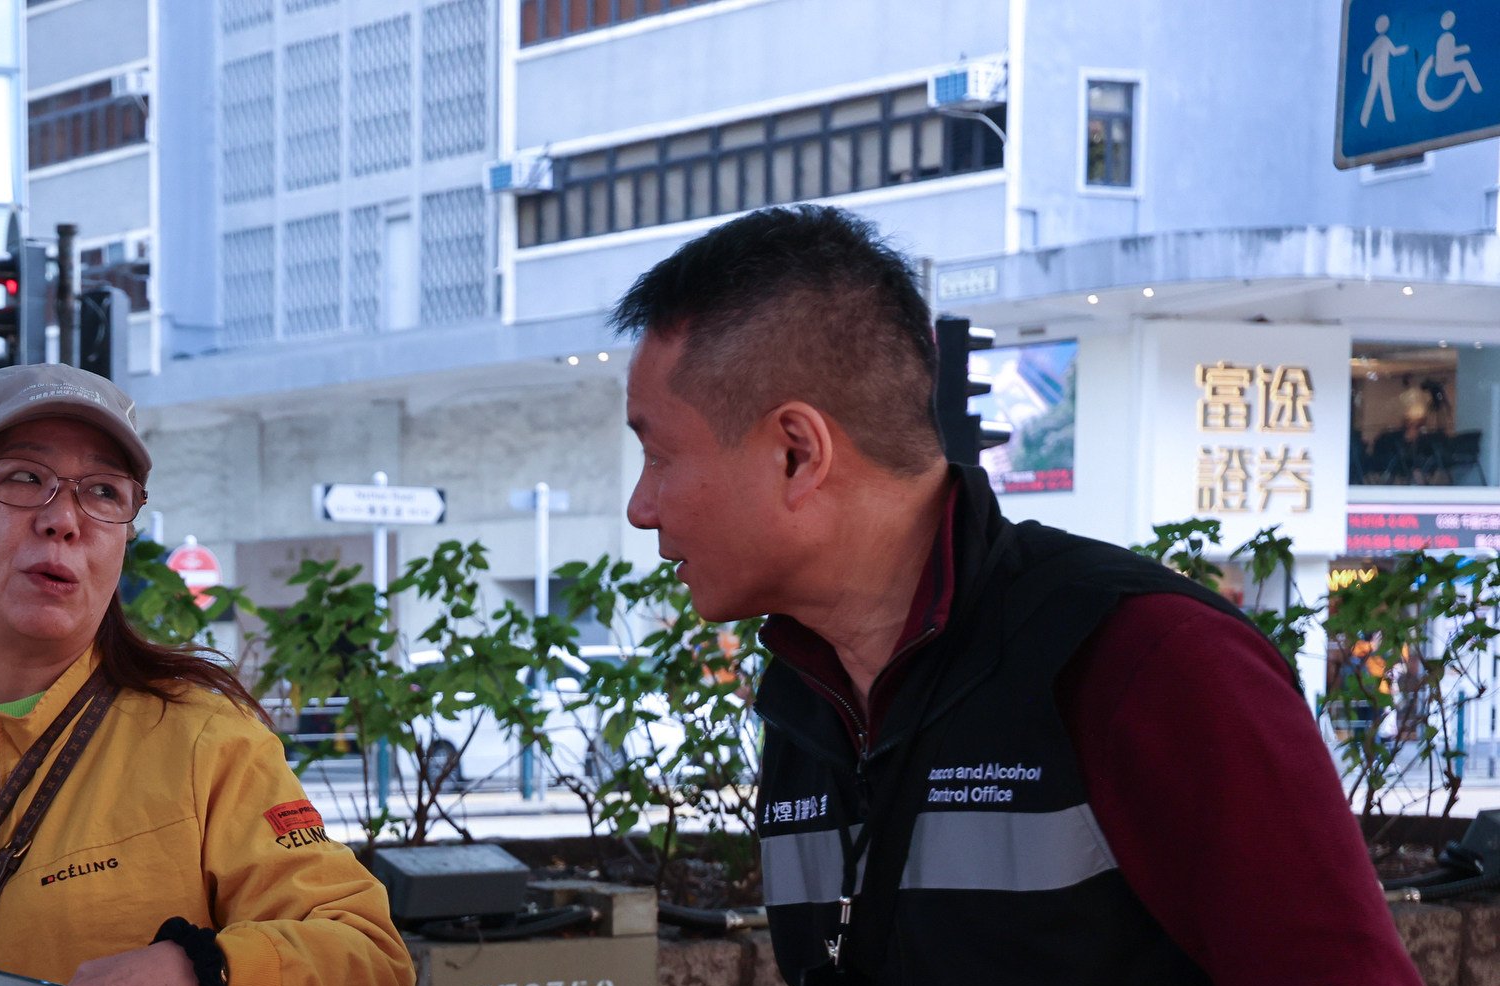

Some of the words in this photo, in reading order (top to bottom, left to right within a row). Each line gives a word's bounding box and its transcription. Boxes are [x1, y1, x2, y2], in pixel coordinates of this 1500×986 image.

[1195, 359, 1314, 433] 富途
[1196, 443, 1314, 514] 證券
[955, 763, 984, 780] and
[983, 763, 1042, 783] Alcohol
[970, 785, 1014, 803] Office
[55, 857, 119, 882] CÉLING
